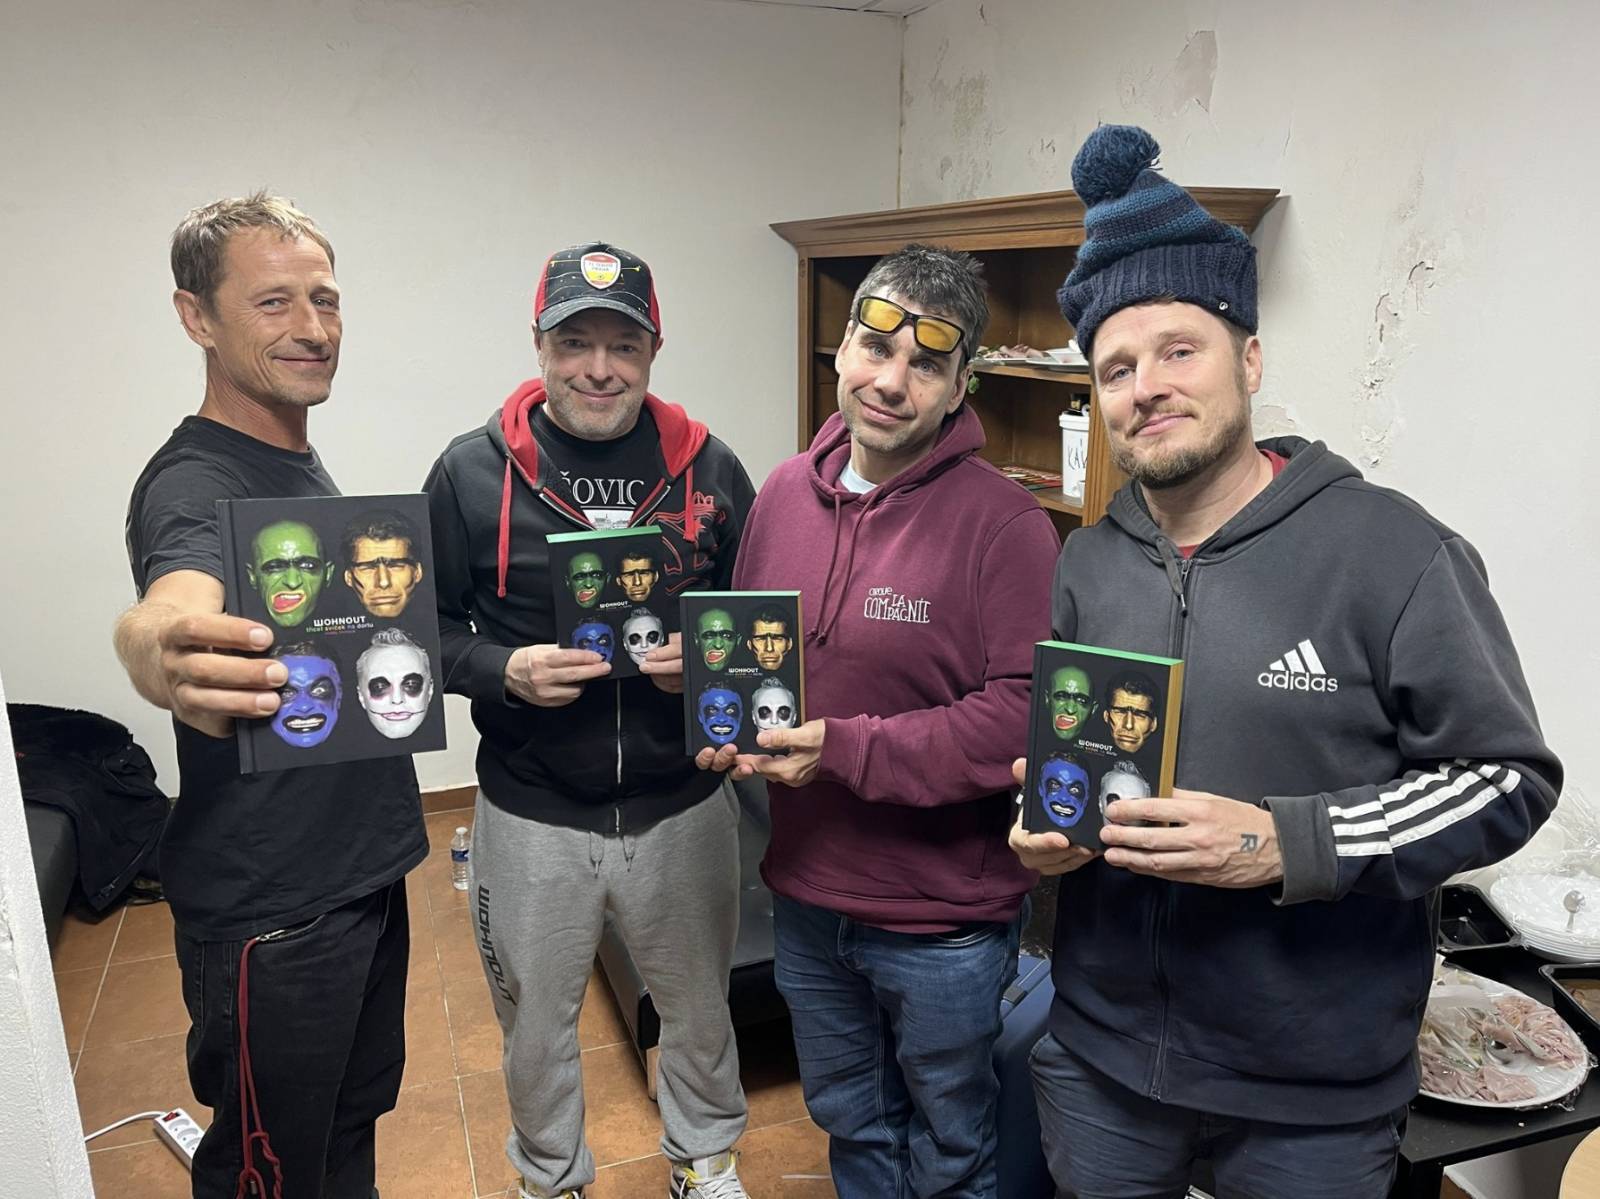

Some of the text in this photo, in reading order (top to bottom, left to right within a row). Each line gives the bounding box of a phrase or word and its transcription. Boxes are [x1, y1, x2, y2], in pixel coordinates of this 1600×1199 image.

[891, 594, 907, 608] LA
[313, 615, 366, 627] WOHNOUT
[1257, 670, 1339, 693] adidas
[1078, 739, 1113, 752] WOHNOUT
[1240, 833, 1258, 853] R
[478, 883, 519, 1008] WOHNOUT
